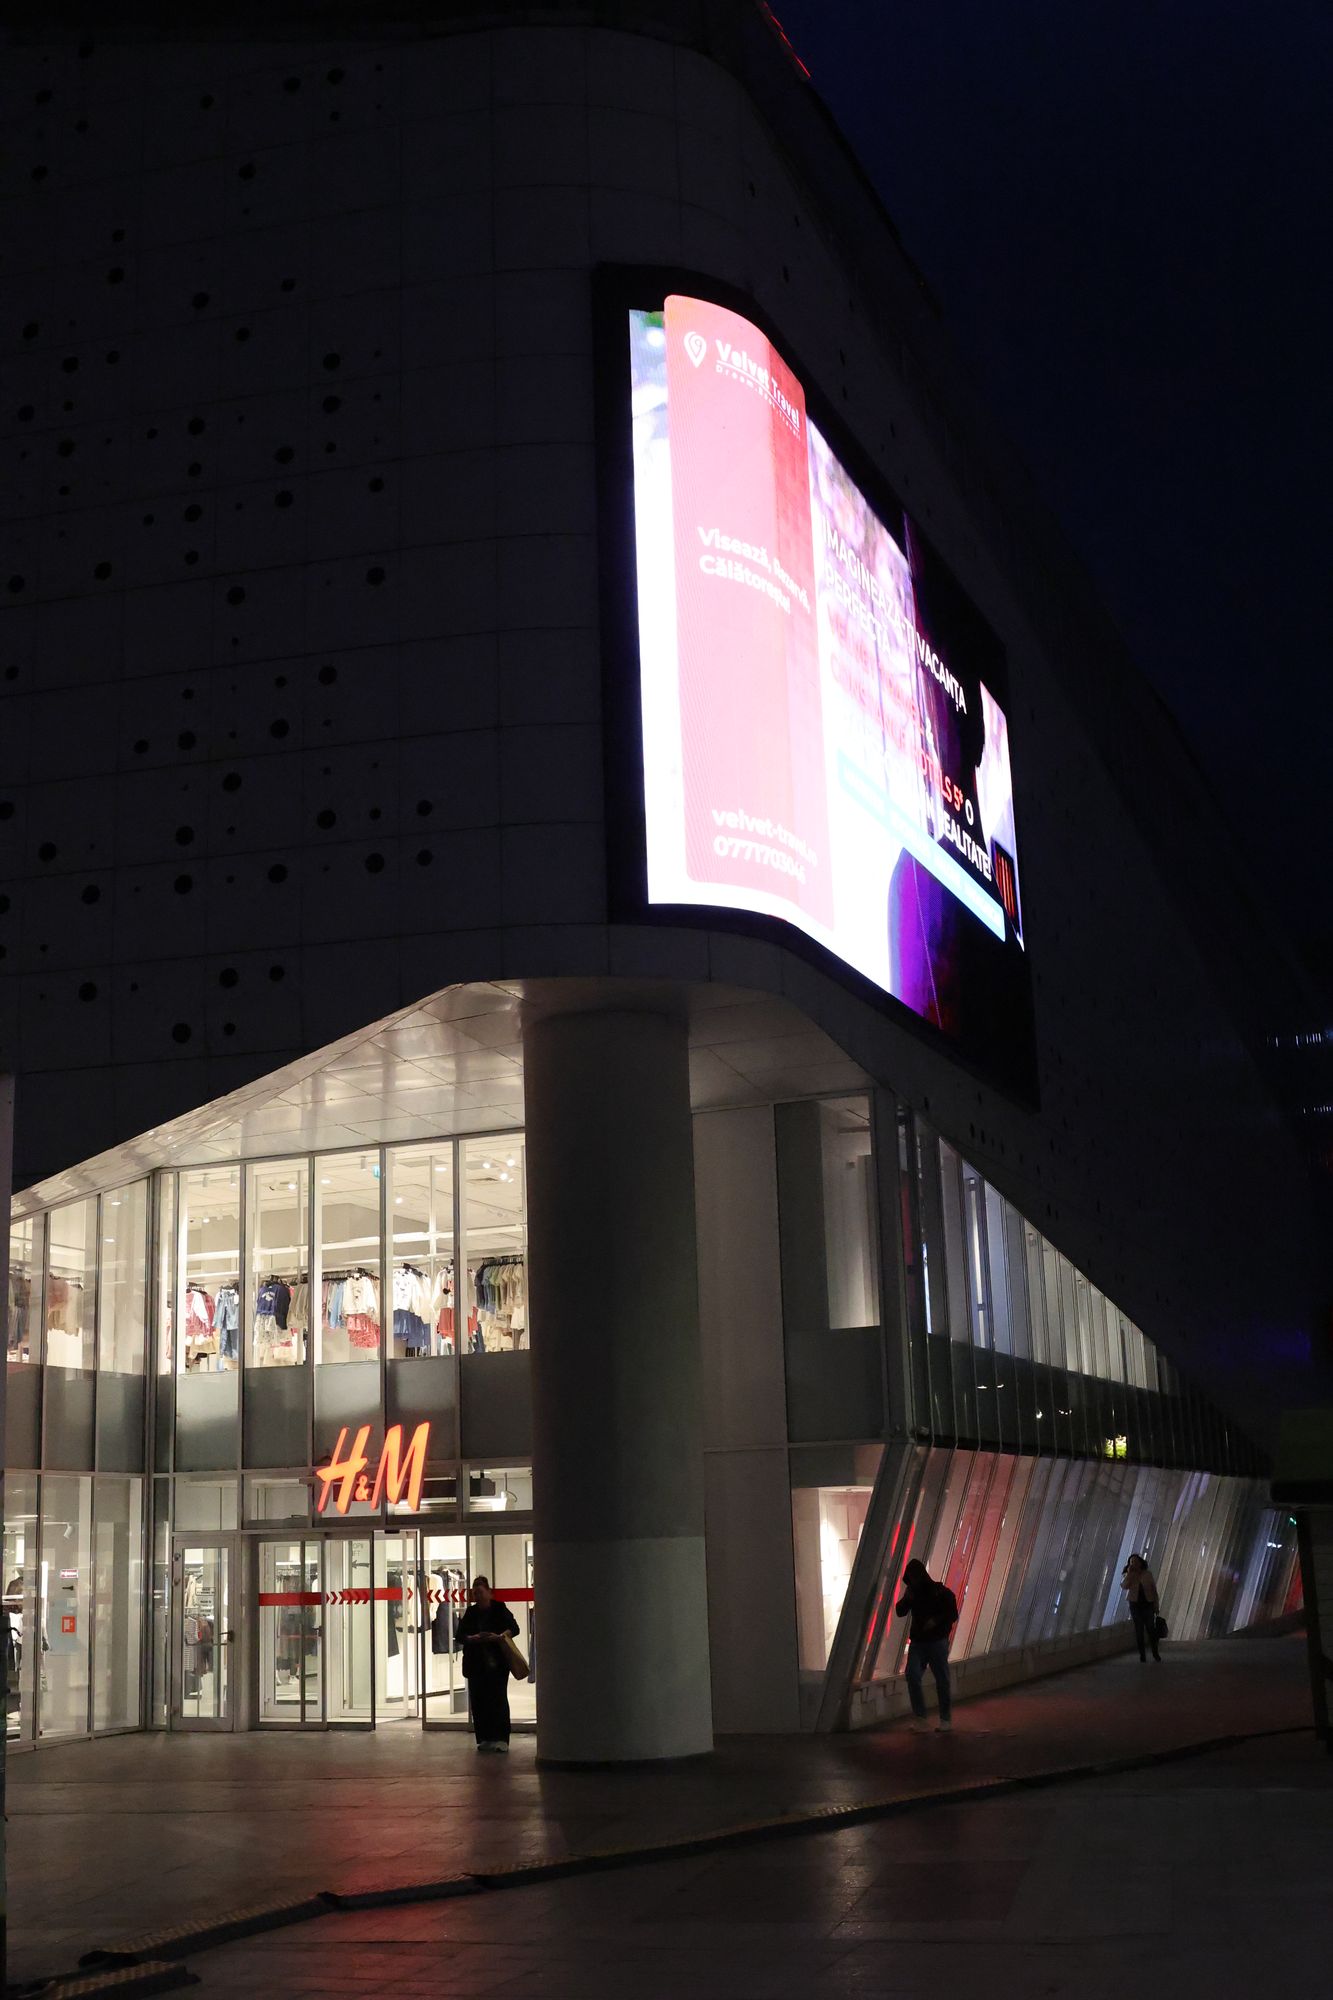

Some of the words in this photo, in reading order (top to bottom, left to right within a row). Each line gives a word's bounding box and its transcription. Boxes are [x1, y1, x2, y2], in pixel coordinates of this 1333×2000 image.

[715, 339, 769, 390] Velvet
[771, 377, 800, 428] Travel
[916, 631, 967, 714] VACANȚA
[924, 717, 934, 744] &
[964, 798, 974, 826] O
[316, 1421, 430, 1514] H&M
